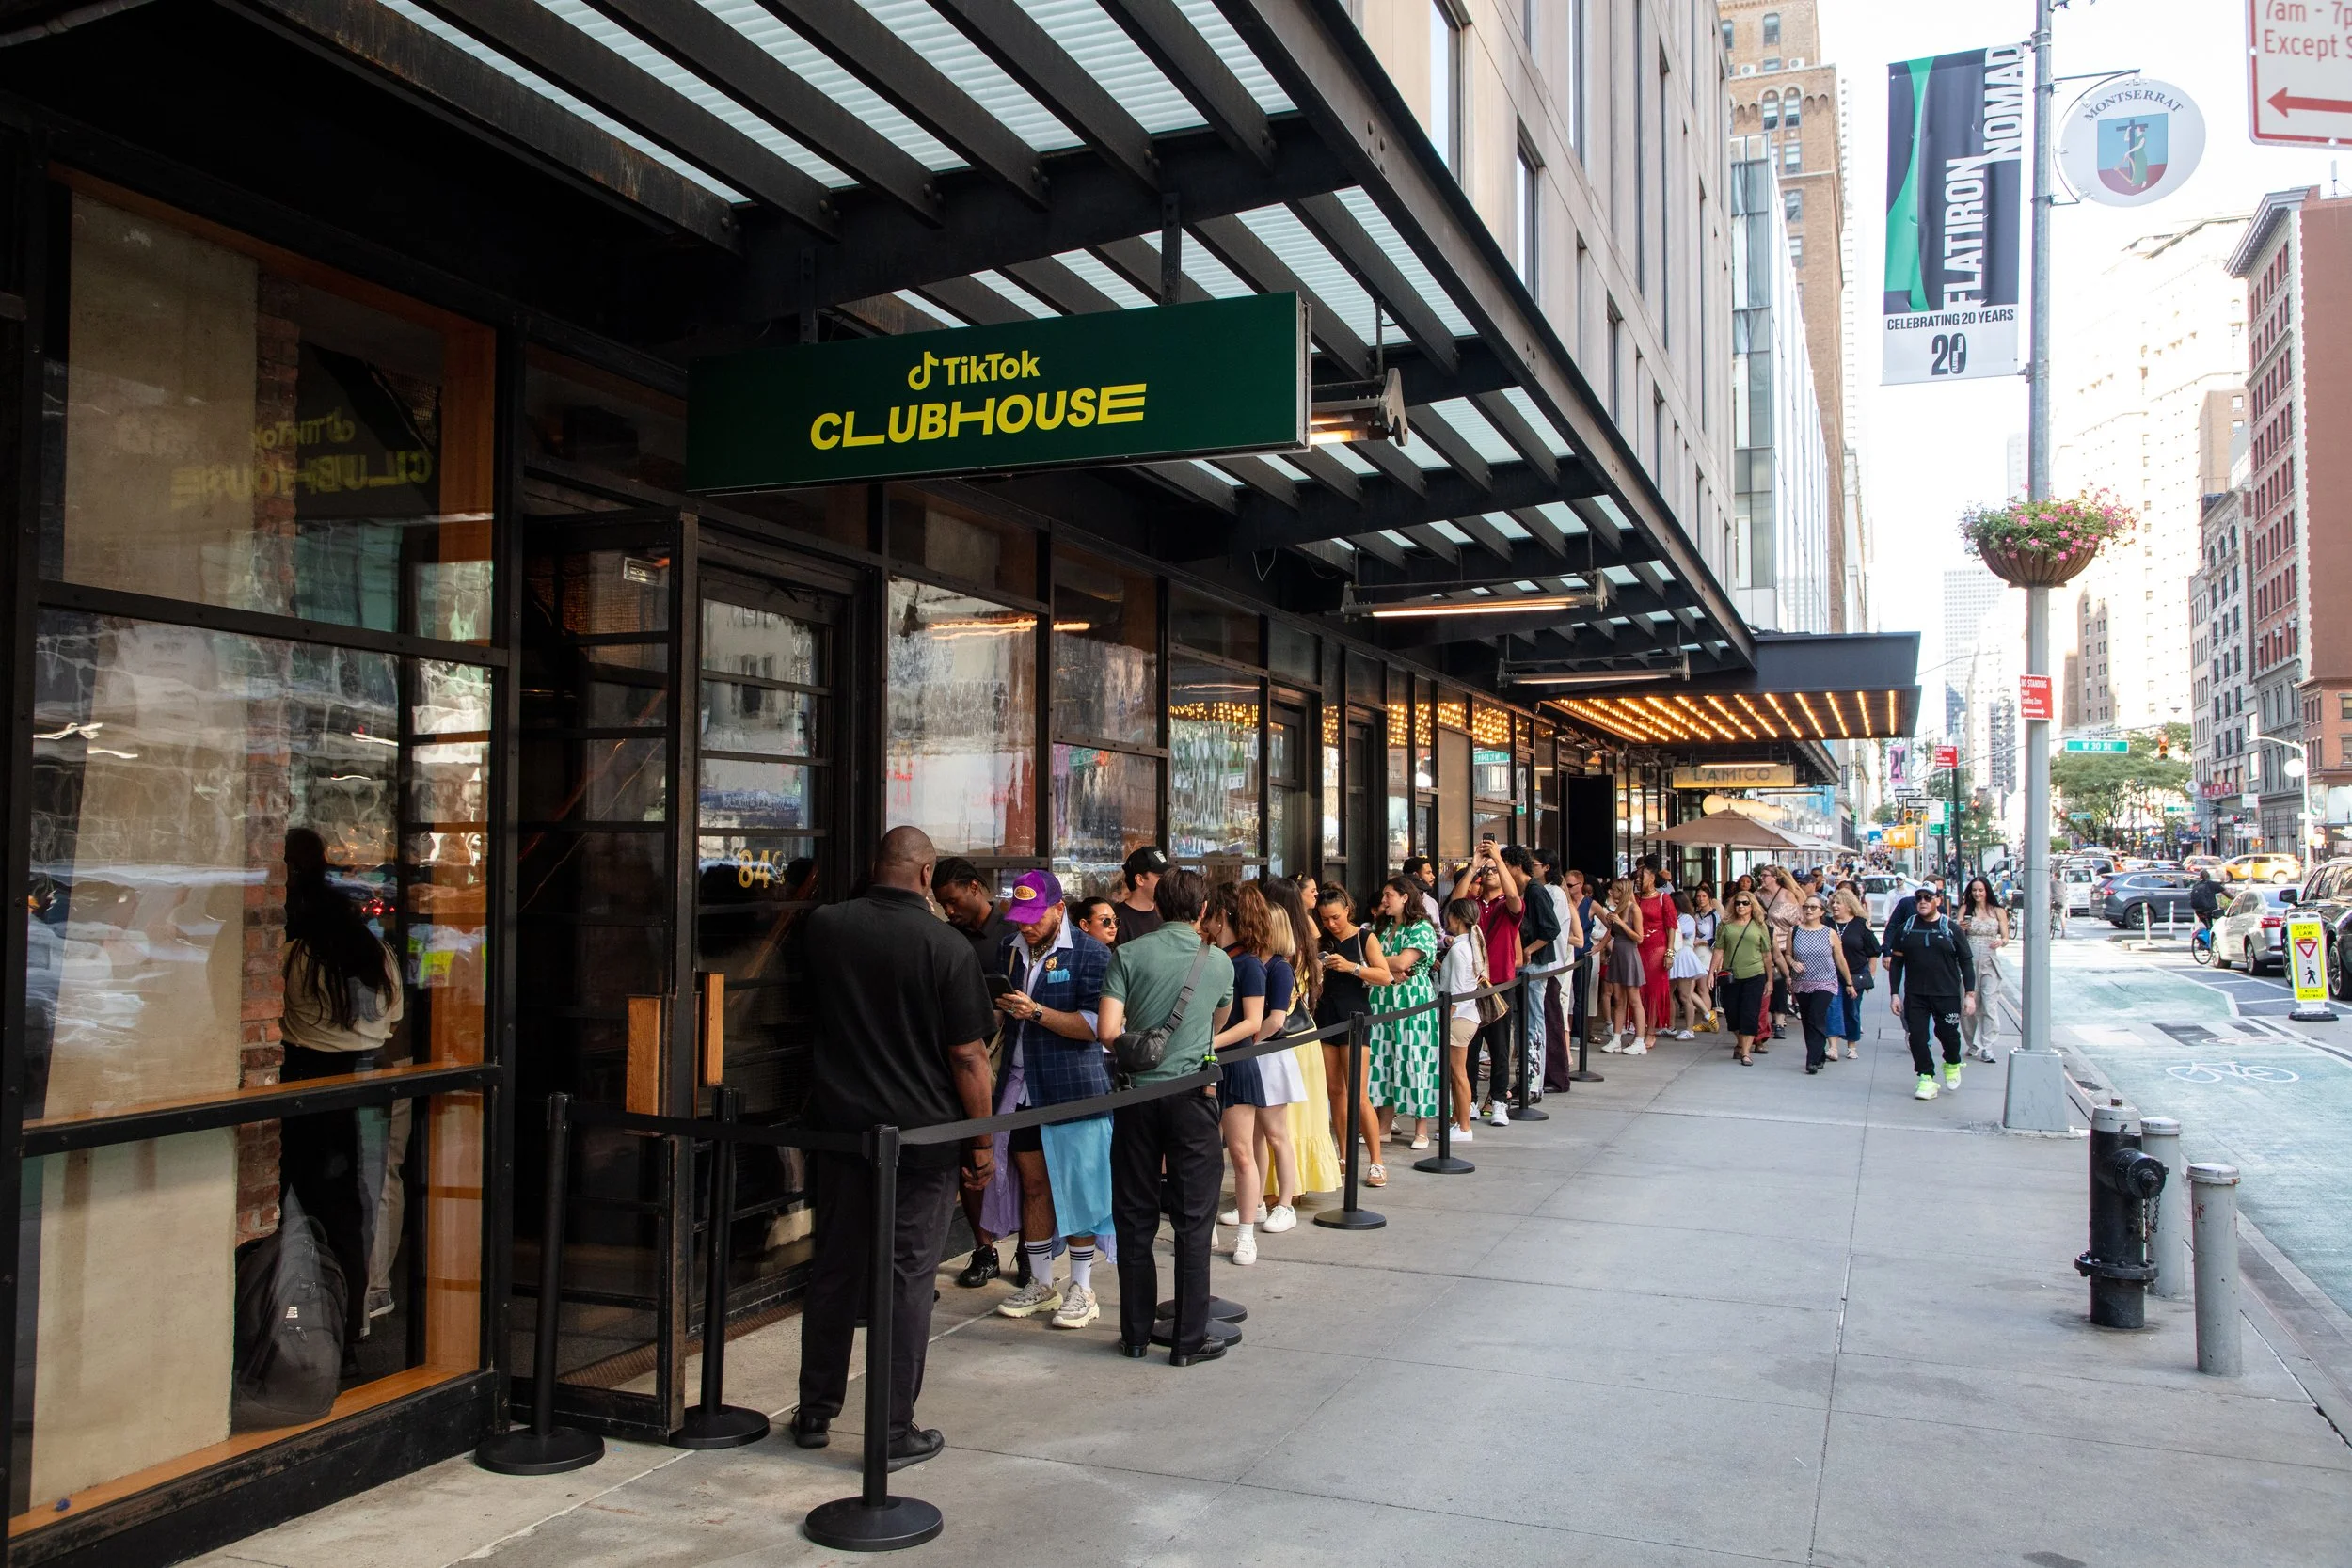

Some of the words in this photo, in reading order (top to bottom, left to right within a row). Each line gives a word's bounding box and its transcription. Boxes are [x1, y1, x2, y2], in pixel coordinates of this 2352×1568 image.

[2264, 29, 2338, 62] Except
[1983, 43, 2023, 162] NOMAD
[2083, 89, 2184, 122] MONTSERRAT
[1943, 156, 1985, 310] FLATIRON
[1887, 313, 1960, 330] CELEBRATING
[1962, 312, 1976, 325] 20
[1979, 309, 2014, 324] YEARS
[943, 350, 1041, 386] TikTok
[1931, 332, 1967, 376] 20
[810, 383, 1147, 451] CLUBHOUSE
[1693, 767, 1770, 782] L'AMICO
